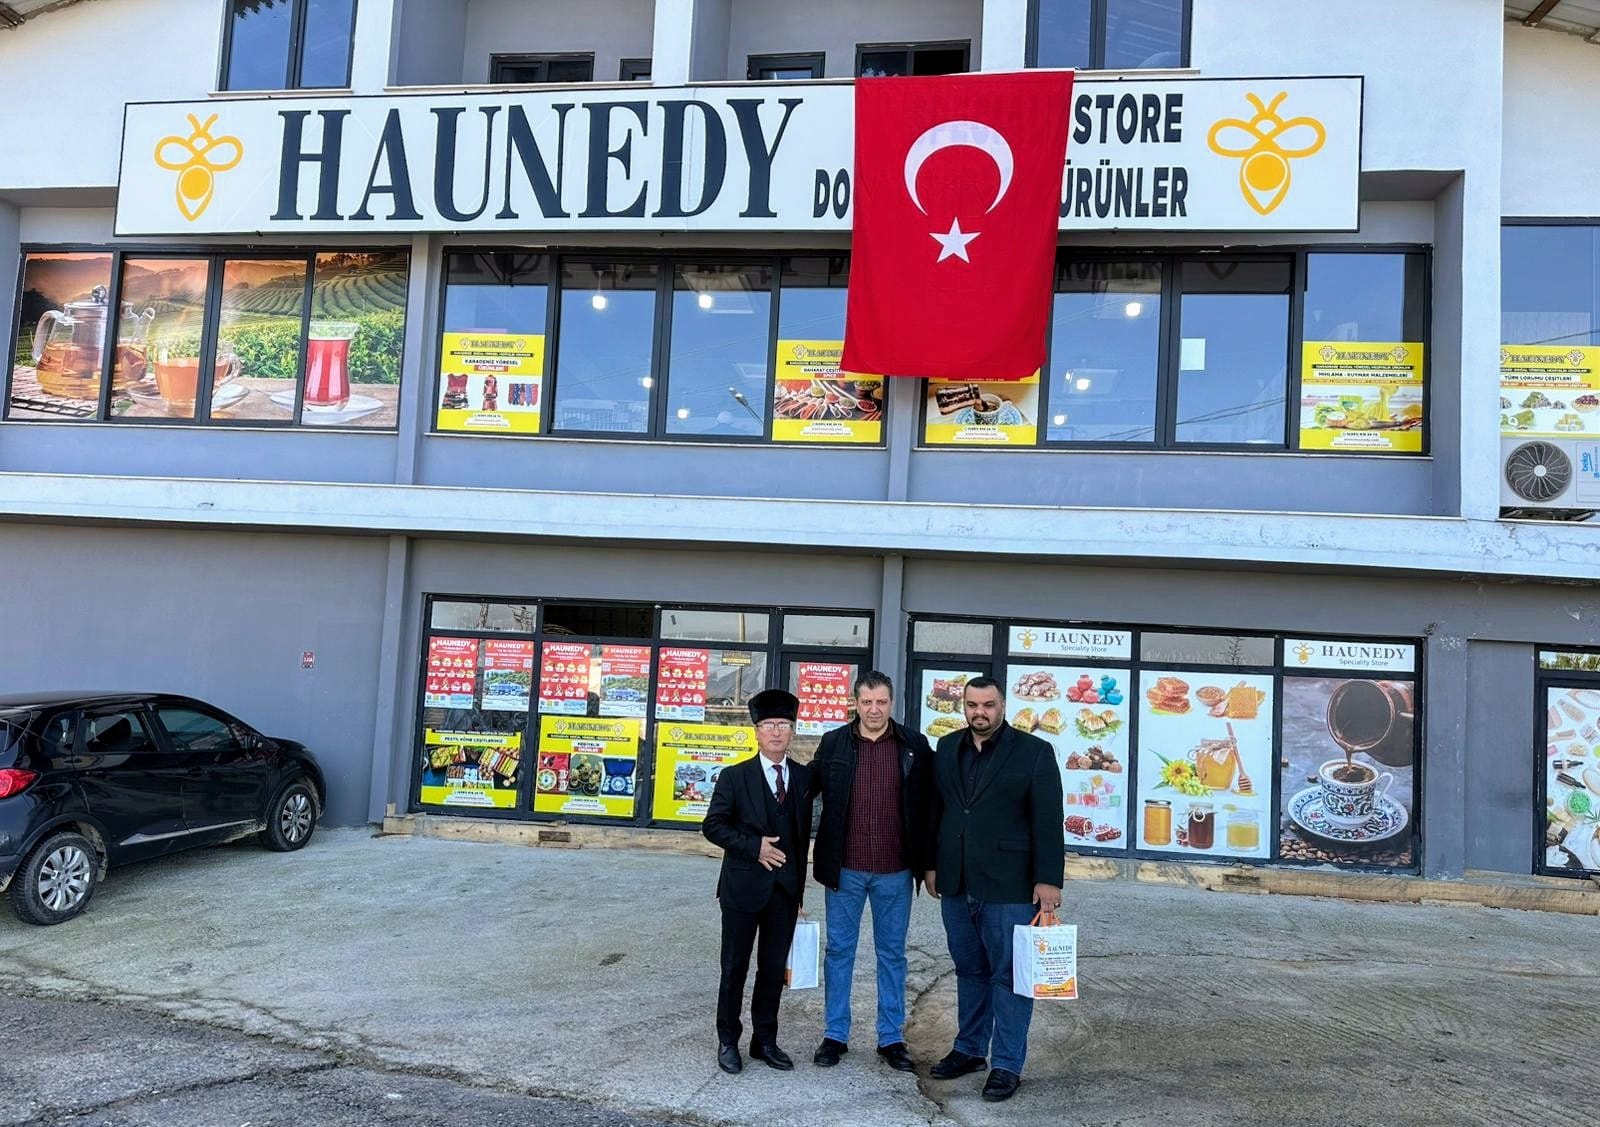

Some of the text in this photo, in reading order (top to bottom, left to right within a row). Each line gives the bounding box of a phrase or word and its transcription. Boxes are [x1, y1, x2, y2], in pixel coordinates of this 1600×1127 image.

[1072, 93, 1184, 145] STORE
[269, 97, 804, 222] HAUNEDY
[436, 639, 471, 648] HAUNEDY
[1045, 632, 1125, 646] HAUNEDY
[550, 644, 585, 653] HAUNEDY
[1061, 645, 1090, 653] Speciality
[1322, 645, 1407, 660] HAUNEDY
[666, 649, 702, 658] HAUNEDY
[1340, 659, 1370, 667] Speciality
[806, 664, 844, 673] HAUNEDY
